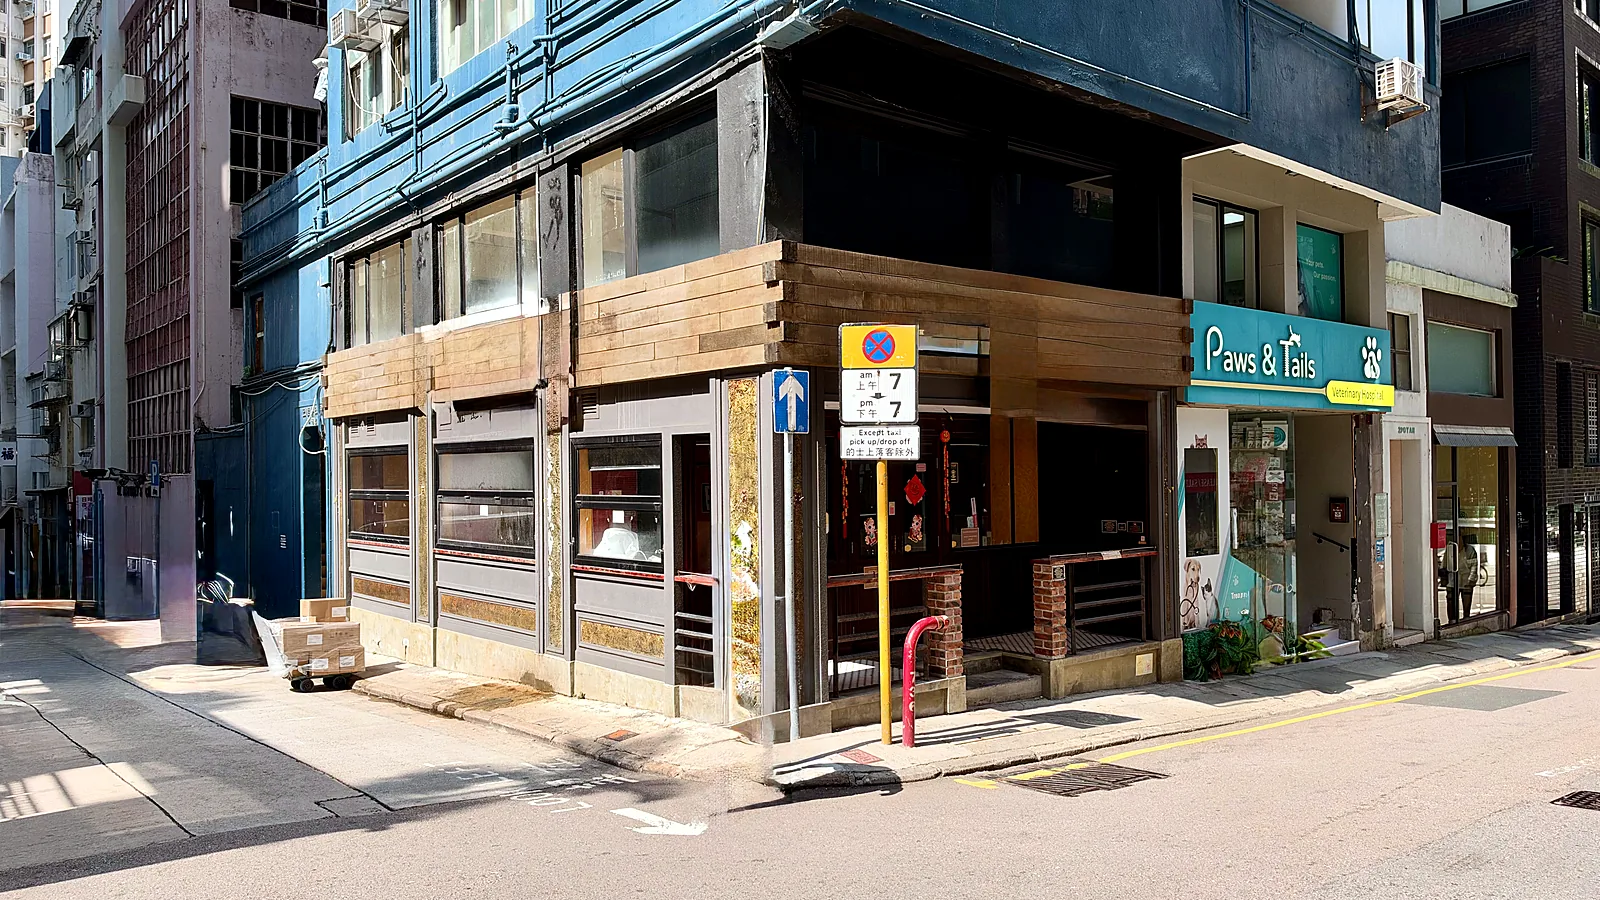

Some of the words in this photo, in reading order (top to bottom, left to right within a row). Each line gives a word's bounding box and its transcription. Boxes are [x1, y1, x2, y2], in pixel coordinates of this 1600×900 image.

[1313, 270, 1321, 279] Our
[1321, 273, 1336, 282] passion.
[1206, 325, 1257, 374] Paws
[1262, 343, 1277, 376] &
[1279, 340, 1316, 379] Tails
[856, 380, 878, 391] 上午
[889, 373, 901, 390] 7
[1332, 387, 1361, 401] Veterinary
[1361, 389, 1384, 402] Hospital
[860, 400, 874, 408] pm
[889, 401, 901, 418] 7
[856, 408, 878, 419] 下午
[858, 429, 885, 437] Except
[849, 438, 865, 446] pick
[867, 438, 898, 446] up/drop
[899, 437, 911, 445] off
[846, 447, 914, 457] 的士上落客除外
[151, 463, 158, 484] P
